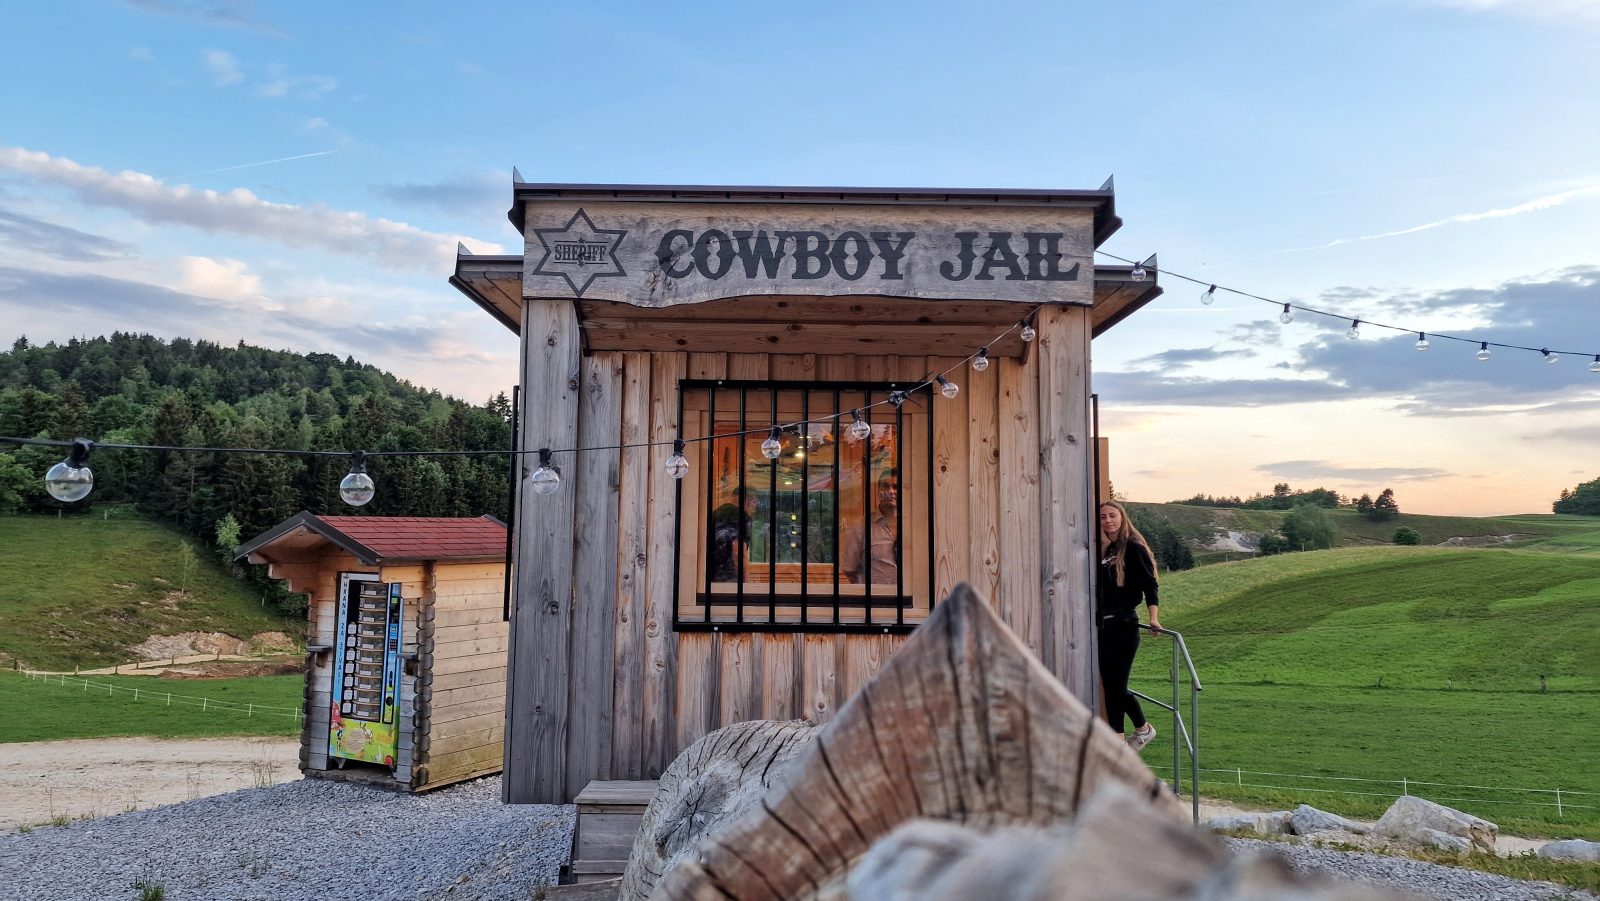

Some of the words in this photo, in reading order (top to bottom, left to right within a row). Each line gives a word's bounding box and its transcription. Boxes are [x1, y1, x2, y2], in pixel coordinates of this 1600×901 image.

[554, 244, 606, 261] SHERIFF
[655, 229, 915, 280] COWBOY
[940, 231, 1080, 281] JAIL
[340, 622, 345, 636] ZA
